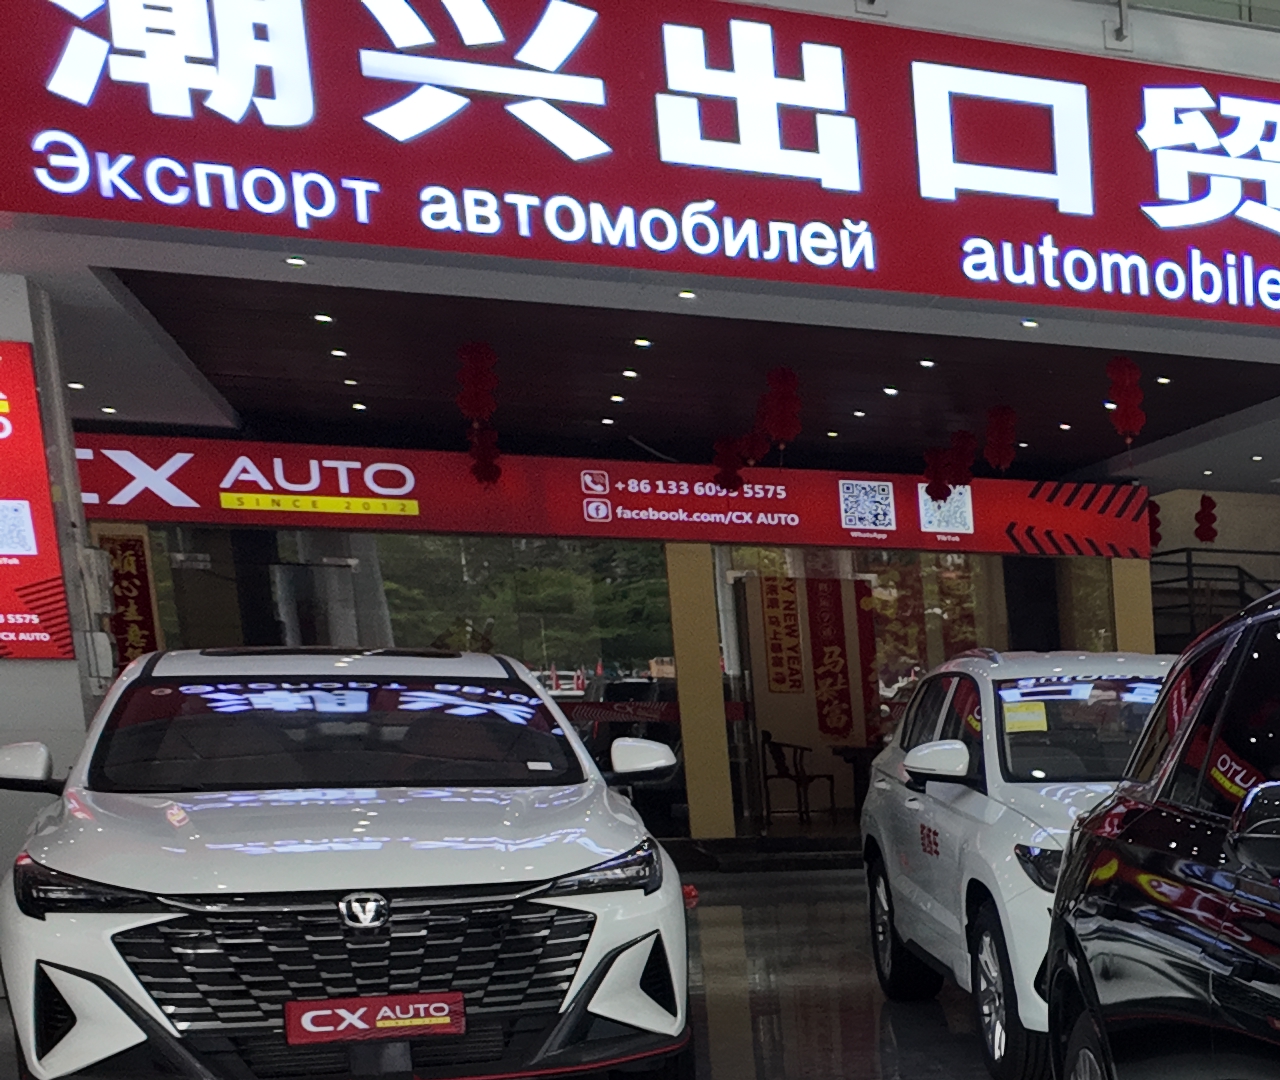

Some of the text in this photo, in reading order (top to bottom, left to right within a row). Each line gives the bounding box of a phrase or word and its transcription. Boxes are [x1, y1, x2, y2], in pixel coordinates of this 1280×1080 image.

[31, 128, 877, 271] Экспорт автомобилей
[75, 448, 416, 508] X AUTO
[614, 479, 650, 494] +86
[656, 480, 689, 496] 133
[743, 484, 787, 499] 5575
[237, 497, 408, 513] SINCE 2012
[616, 505, 799, 527] facebook.com/CX AUTO
[782, 600, 799, 639] NEW
[786, 643, 802, 689] YEAR
[301, 1003, 450, 1033] CX AUTO
